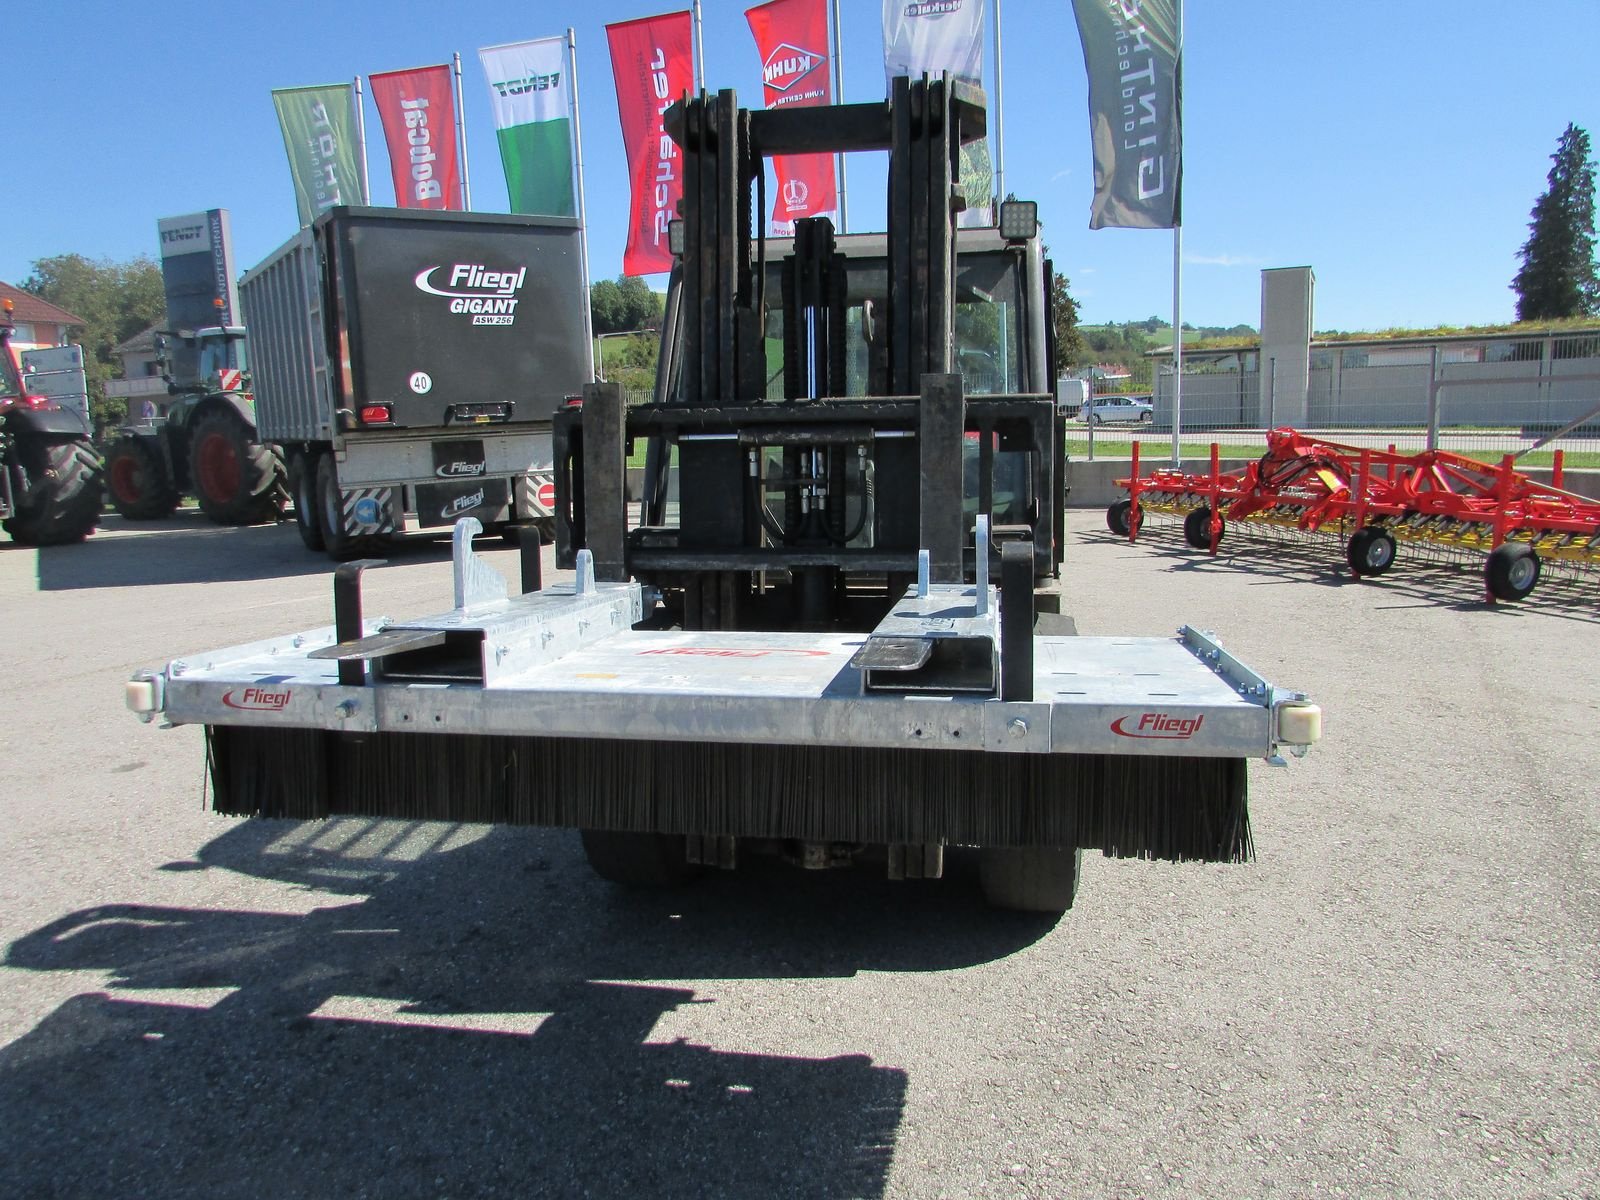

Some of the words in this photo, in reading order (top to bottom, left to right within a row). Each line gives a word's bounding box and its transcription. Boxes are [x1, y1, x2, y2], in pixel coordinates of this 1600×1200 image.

[449, 264, 527, 294] Fliegl
[450, 299, 518, 314] GIGANT
[474, 316, 495, 324] ASW
[495, 316, 512, 324] 256
[414, 376, 427, 390] 40
[450, 461, 486, 474] Fliegl
[453, 488, 485, 511] Fliegl
[243, 688, 292, 708] Fliegl
[1138, 713, 1204, 736] Fliegl
